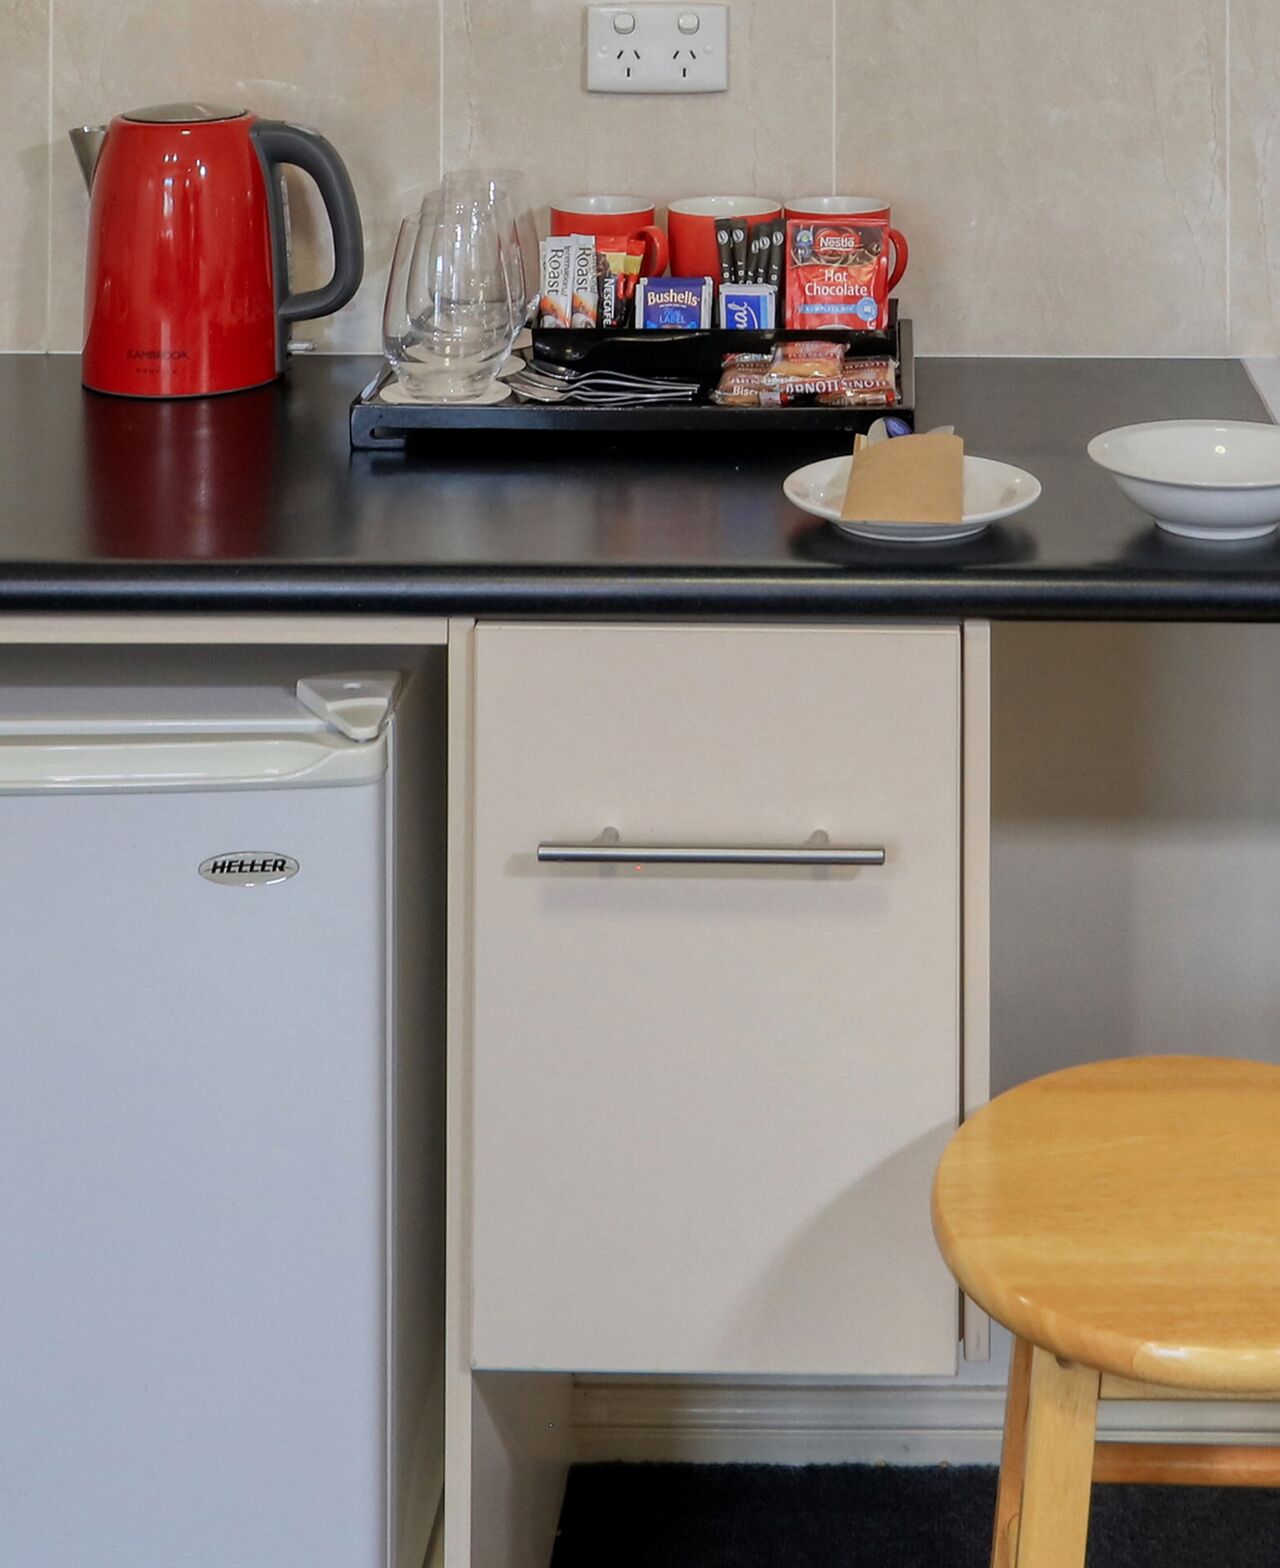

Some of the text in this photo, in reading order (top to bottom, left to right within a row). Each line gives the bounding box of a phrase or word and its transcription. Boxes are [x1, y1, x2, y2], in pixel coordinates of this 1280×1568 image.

[547, 248, 565, 295] Roast
[576, 246, 592, 293] Roast
[824, 269, 848, 282] Hot
[805, 282, 868, 296] Chocolate
[647, 288, 699, 306] Bushells
[659, 315, 686, 324] LABEL
[211, 858, 287, 873] HELLER
